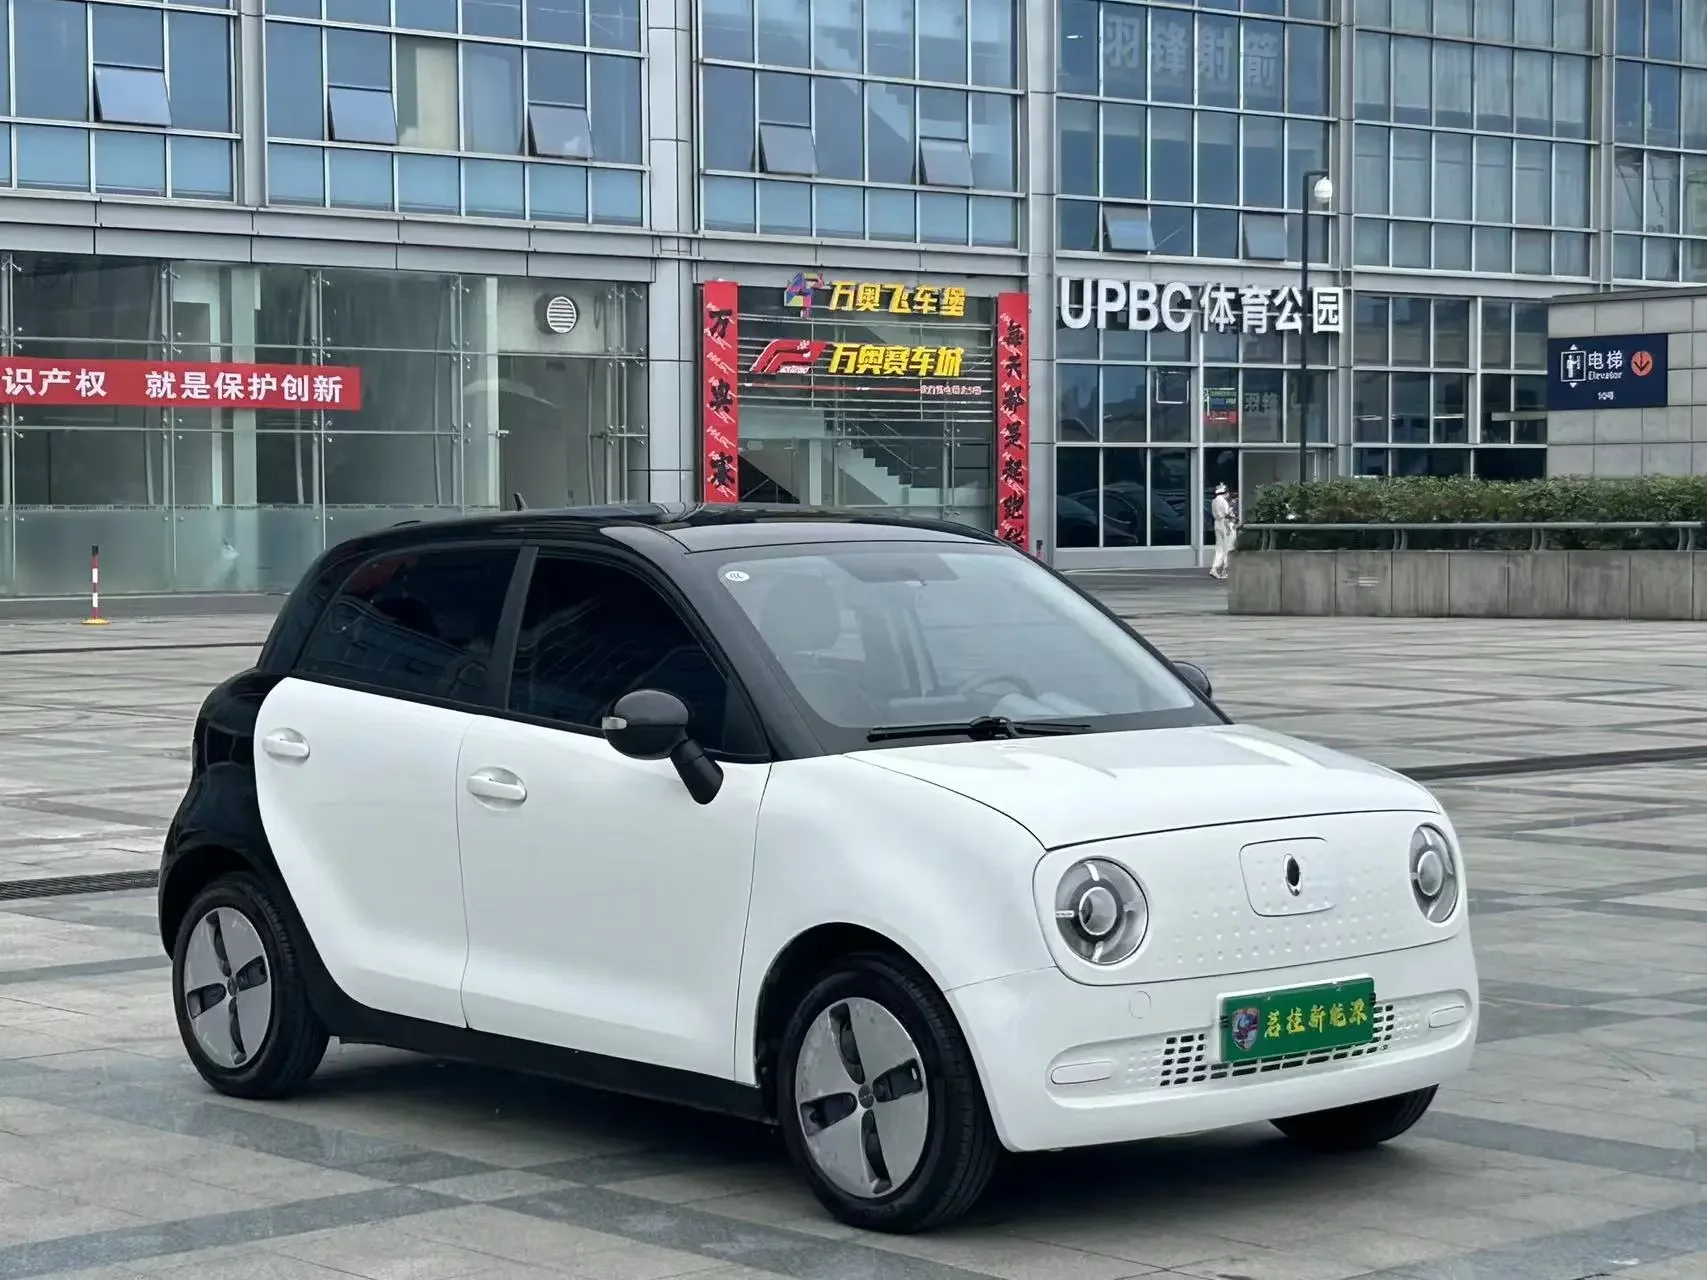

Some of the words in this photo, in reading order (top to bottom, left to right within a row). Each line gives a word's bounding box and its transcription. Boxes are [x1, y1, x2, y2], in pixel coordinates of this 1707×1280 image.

[829, 280, 965, 316] 万奥飞车堡
[828, 343, 964, 377] 万奥赛车城
[1588, 350, 1623, 369] 电梯
[2, 368, 107, 397] 识产权
[145, 370, 343, 403] 就是保护创新
